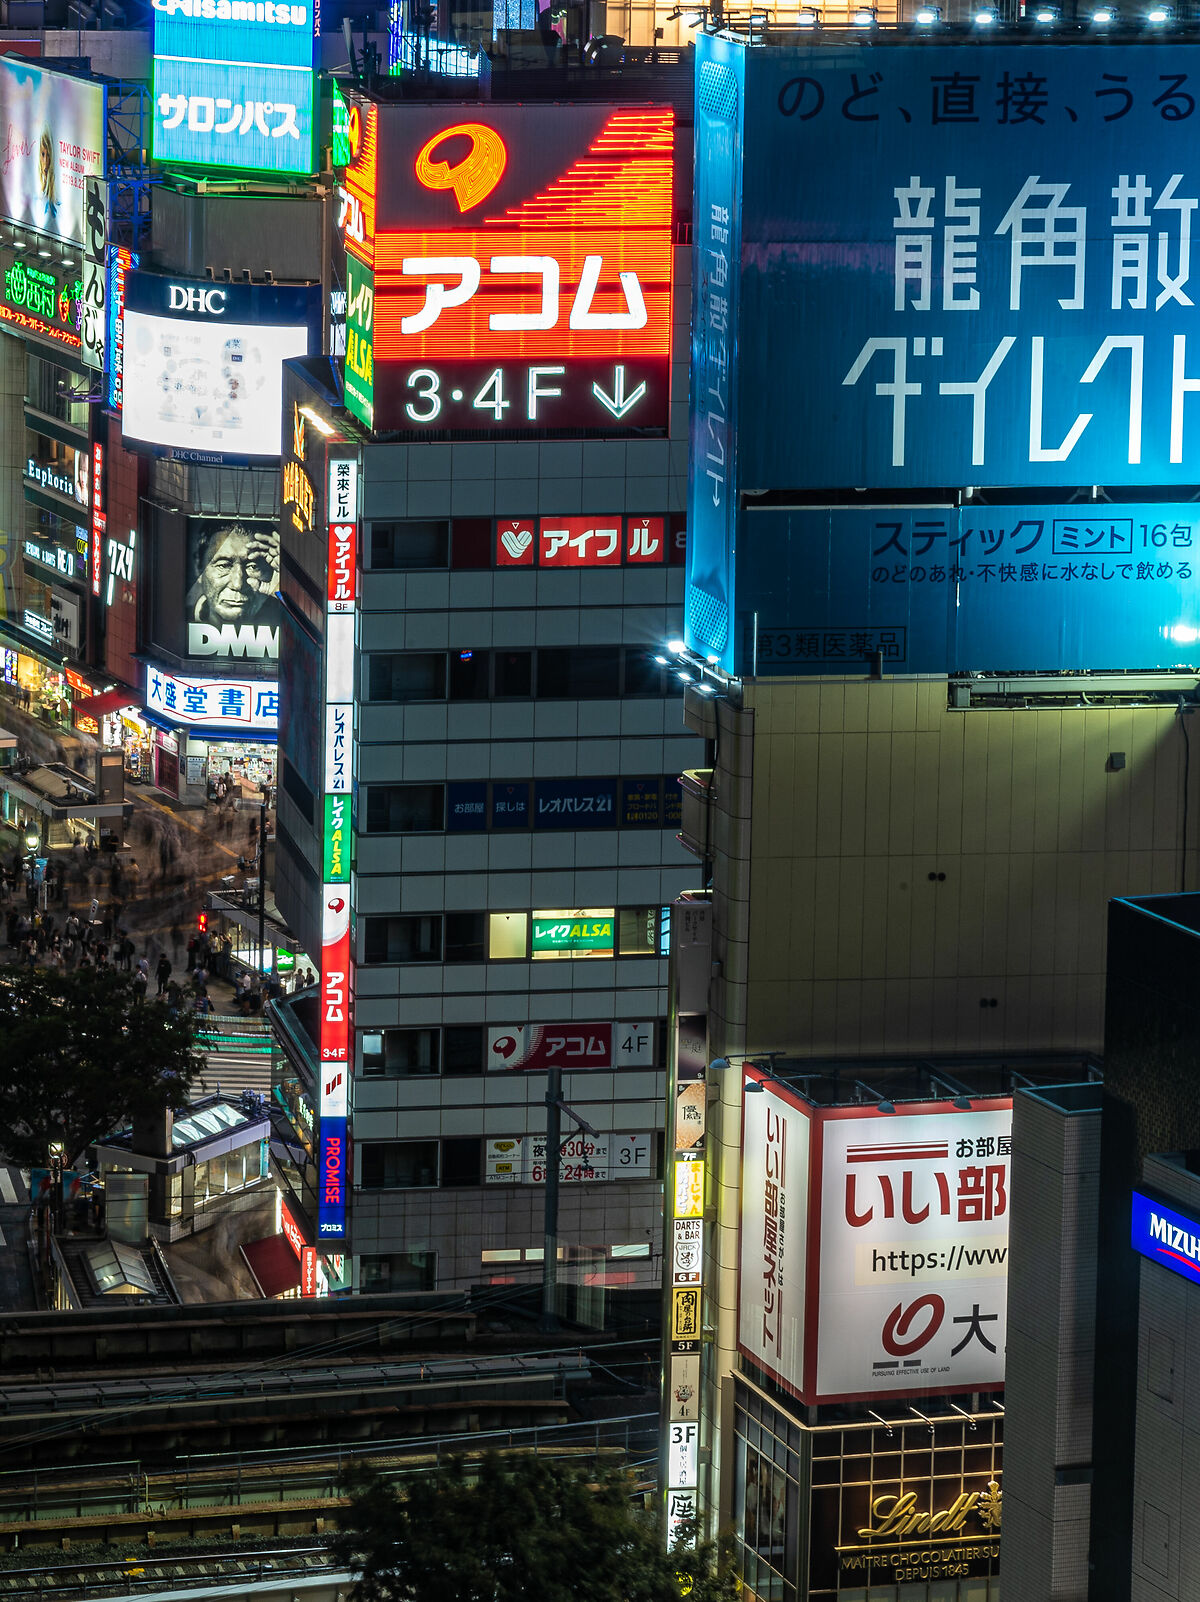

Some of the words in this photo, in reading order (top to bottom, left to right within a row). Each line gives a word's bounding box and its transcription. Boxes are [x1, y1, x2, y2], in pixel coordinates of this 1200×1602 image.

[777, 71, 1196, 126] のど、直接、うる
[157, 93, 300, 140] サロンパス
[59, 141, 81, 158] TAYLOR
[82, 150, 100, 165] SWIFT
[70, 162, 85, 174] ALBUM
[337, 186, 365, 243] アコム
[893, 174, 1200, 313] 龍角散
[26, 280, 56, 319] 西村
[169, 286, 226, 314] DHC
[348, 272, 373, 331] レイク
[400, 255, 648, 335] アコム
[346, 328, 373, 386] ALSA
[171, 449, 191, 459] DHC
[191, 452, 223, 463] Channel
[27, 459, 74, 494] Euphoria
[543, 528, 659, 558] アイフル
[873, 519, 1045, 557] スティック
[1059, 524, 1127, 550] ミント
[1140, 522, 1193, 549] 16包
[334, 541, 351, 600] アイフル
[871, 560, 1193, 584] のどのあれ・不快感に水なしで飲める
[334, 603, 348, 611] 8F
[753, 630, 901, 659] 第3類医薬品
[151, 674, 280, 718] 大盛堂書店
[333, 708, 345, 789] レオパレス21
[331, 796, 344, 829] レイク
[454, 802, 485, 814] お部屋
[496, 802, 526, 813] 探しは
[539, 794, 612, 813] レオパレス21
[331, 829, 343, 875] ALSA
[326, 972, 344, 1022] アコム
[546, 1037, 606, 1057] アコム
[622, 1036, 649, 1053] 4F
[325, 1137, 340, 1204] PROMISE
[619, 1147, 648, 1165] 3F
[682, 1152, 697, 1162] 7F
[690, 1162, 701, 1215] まーじゃん
[845, 1164, 1007, 1228] いい部
[320, 1224, 343, 1232] プロミス
[675, 1221, 701, 1231] DARTS
[685, 1230, 701, 1240] BAR
[763, 1107, 780, 1349] いい部屋ネット
[678, 1273, 700, 1282] 6F
[681, 1293, 694, 1332] 肉屋の台所
[678, 1341, 694, 1350] 5F
[951, 1303, 999, 1358] 大
[678, 1405, 690, 1417] 4F
[672, 1426, 696, 1444] 3F
[857, 1491, 981, 1538] Lindt
[840, 1554, 888, 1570] MAÎTRE
[890, 1548, 981, 1566] CHOCOLATIER
[895, 1566, 939, 1581] DEPUIS
[942, 1563, 969, 1577] 1845
